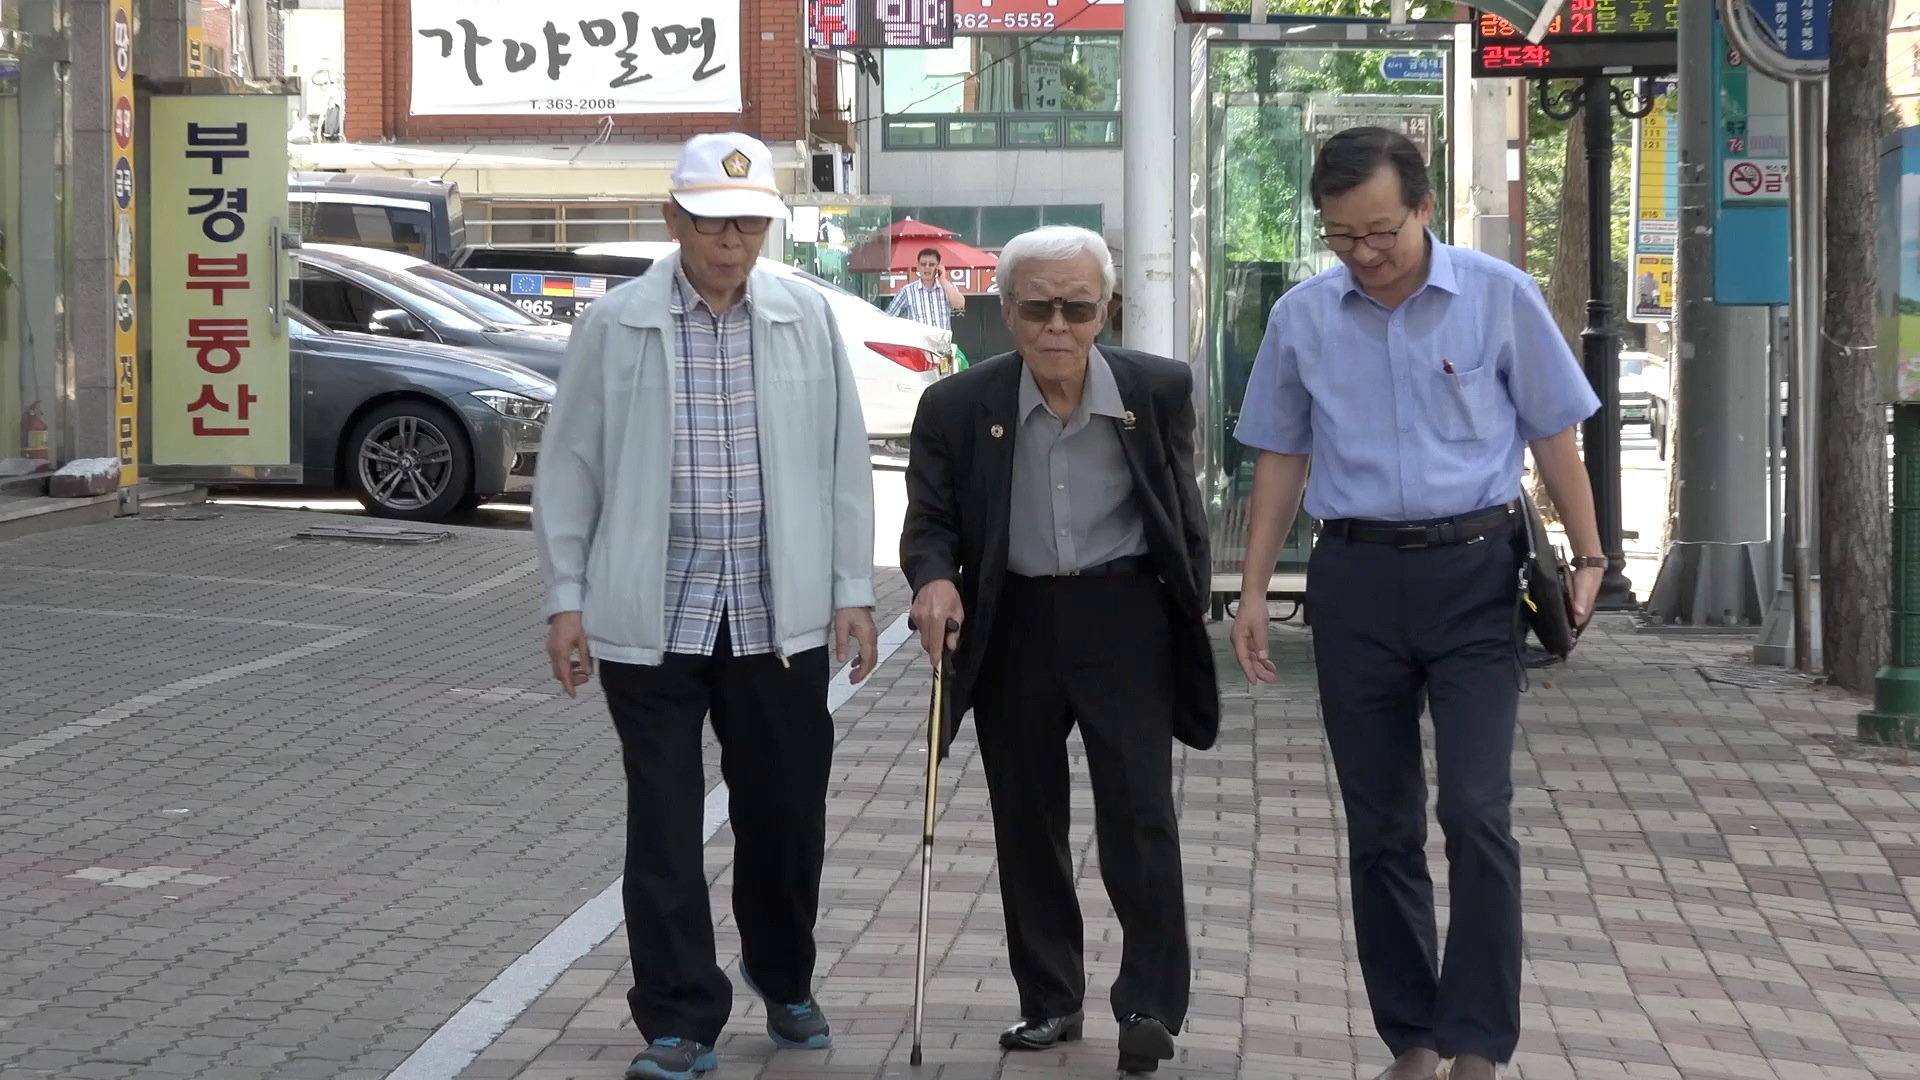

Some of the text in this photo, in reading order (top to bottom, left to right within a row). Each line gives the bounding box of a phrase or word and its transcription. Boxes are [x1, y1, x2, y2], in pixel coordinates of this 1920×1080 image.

[418, 11, 726, 88] 가야밀면
[529, 99, 616, 110] T. 363-2008
